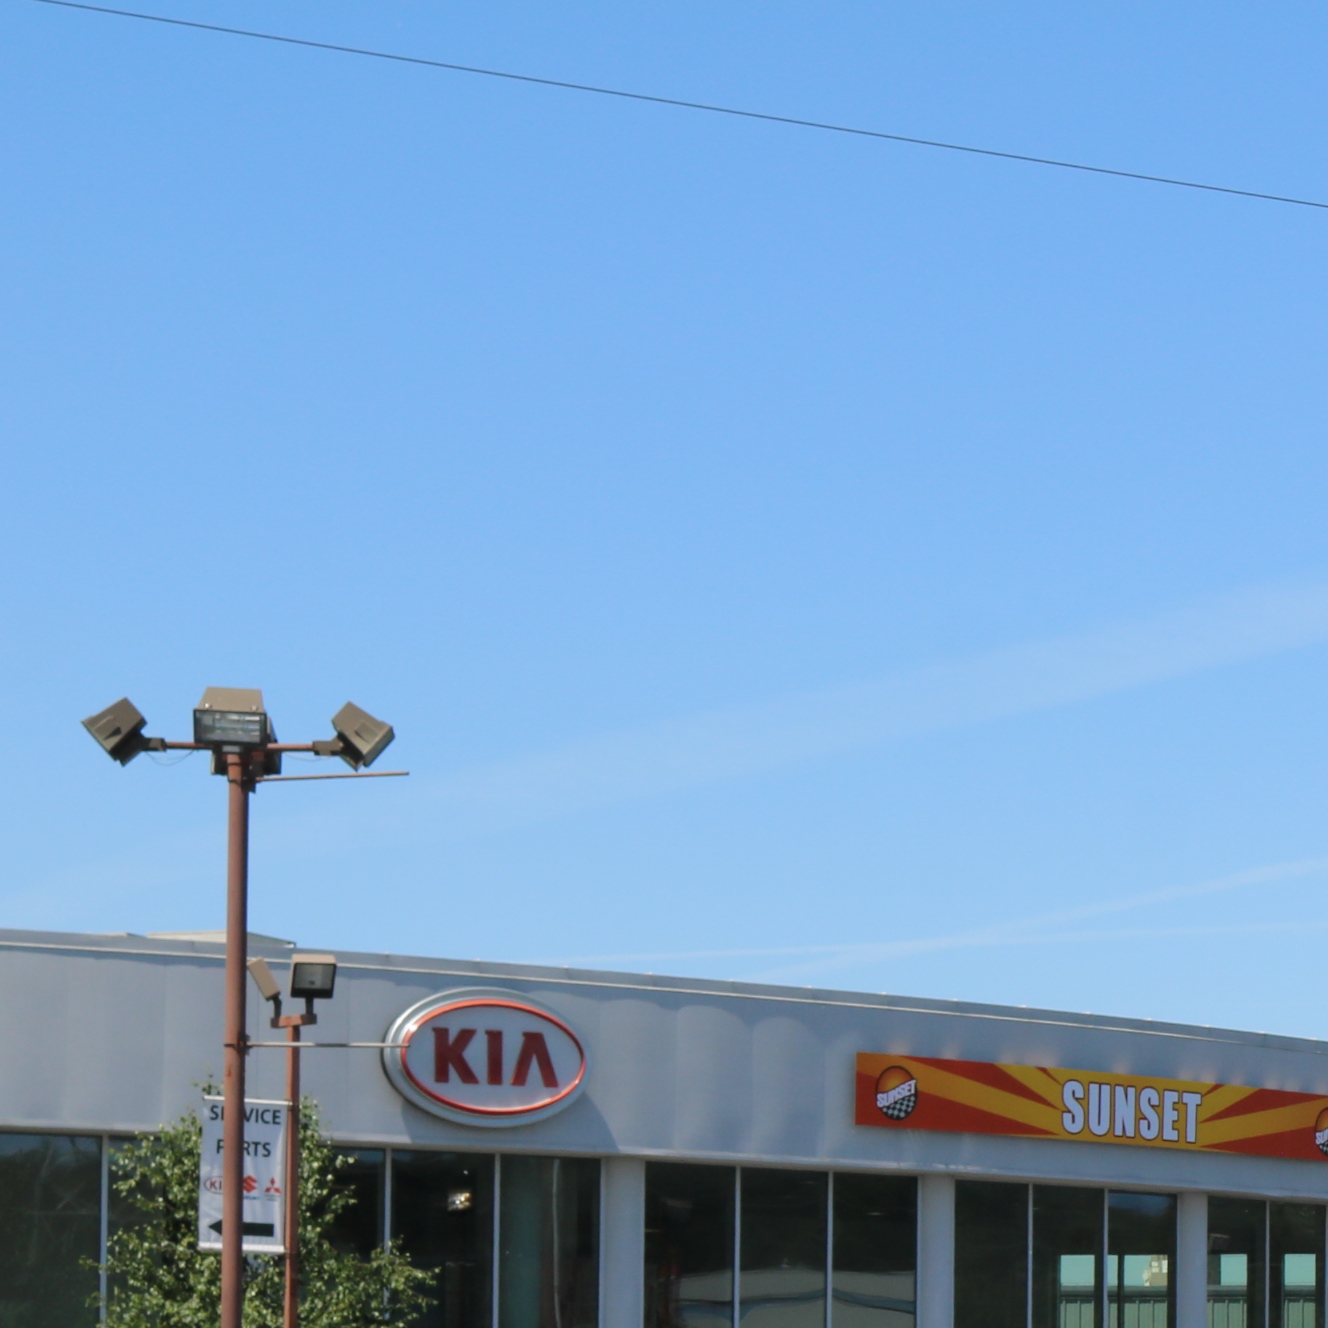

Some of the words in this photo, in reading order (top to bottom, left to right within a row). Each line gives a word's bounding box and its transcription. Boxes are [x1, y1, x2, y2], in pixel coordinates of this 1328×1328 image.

[432, 1027, 559, 1088] KIA
[876, 1079, 916, 1108] SUNSET
[210, 1105, 281, 1125] SVICE
[1062, 1079, 1202, 1144] SUNSET
[216, 1139, 271, 1157] PRTS
